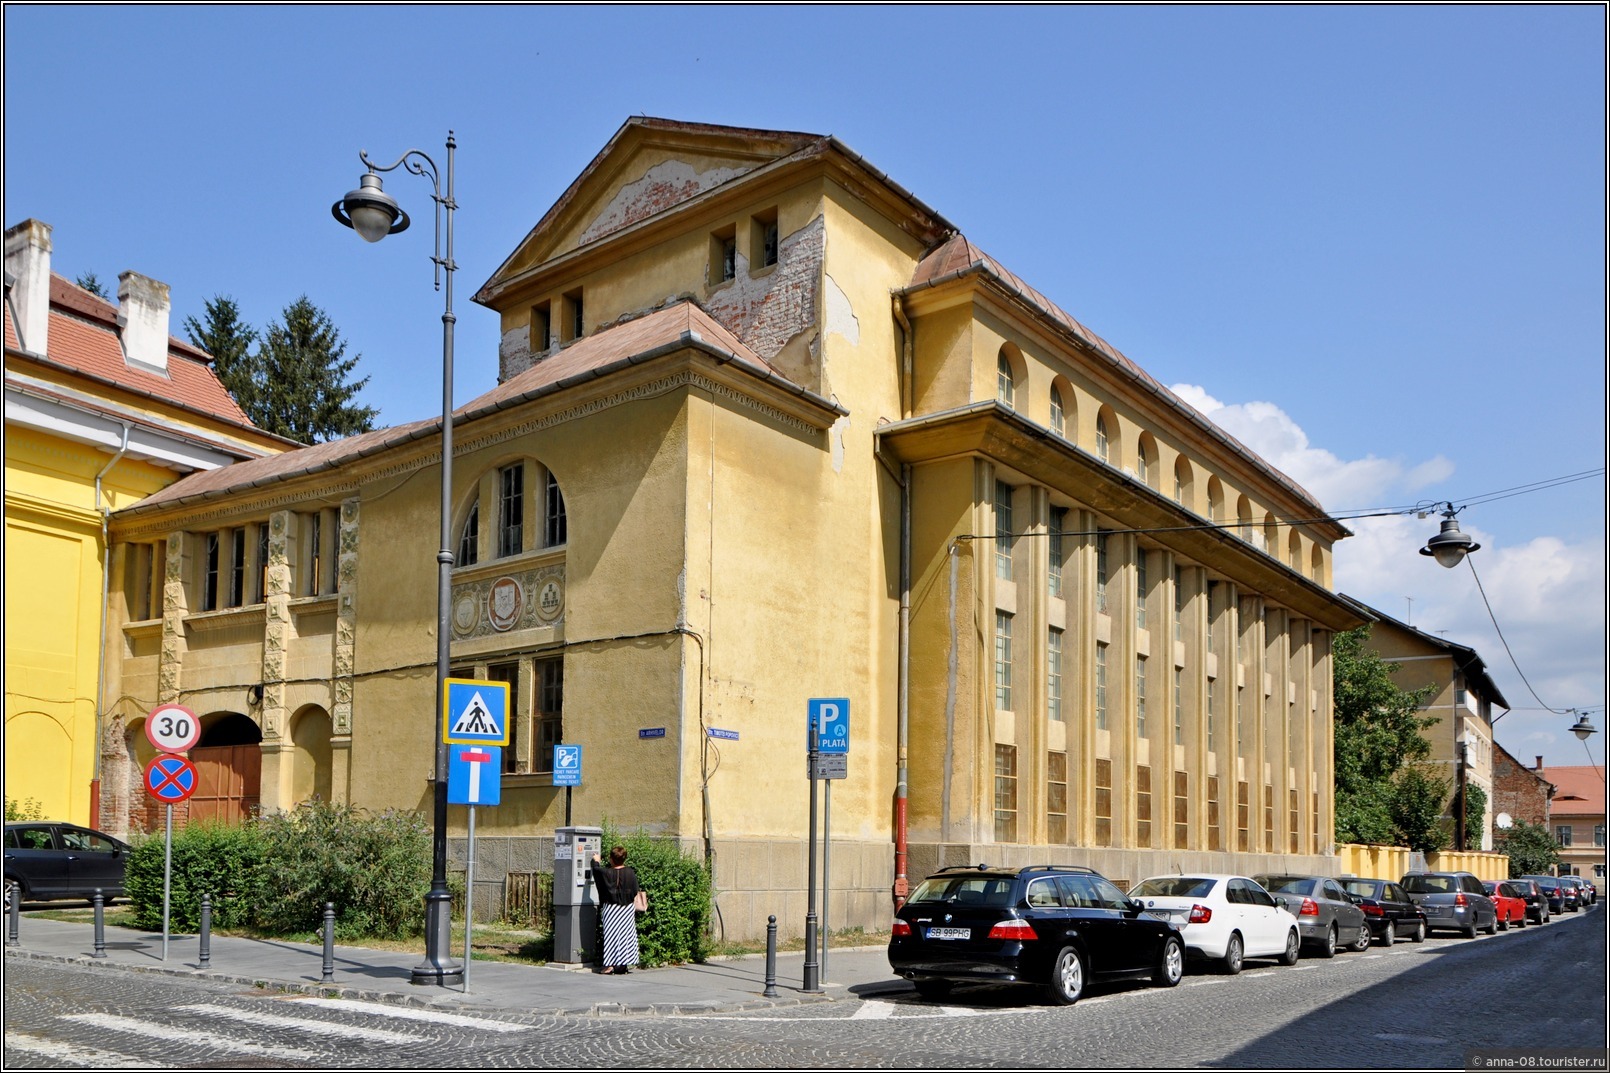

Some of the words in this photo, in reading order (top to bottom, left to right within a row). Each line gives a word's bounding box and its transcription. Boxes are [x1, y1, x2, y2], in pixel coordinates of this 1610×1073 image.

[159, 716, 190, 739] 30
[819, 703, 840, 735] P
[930, 928, 942, 937] SB
